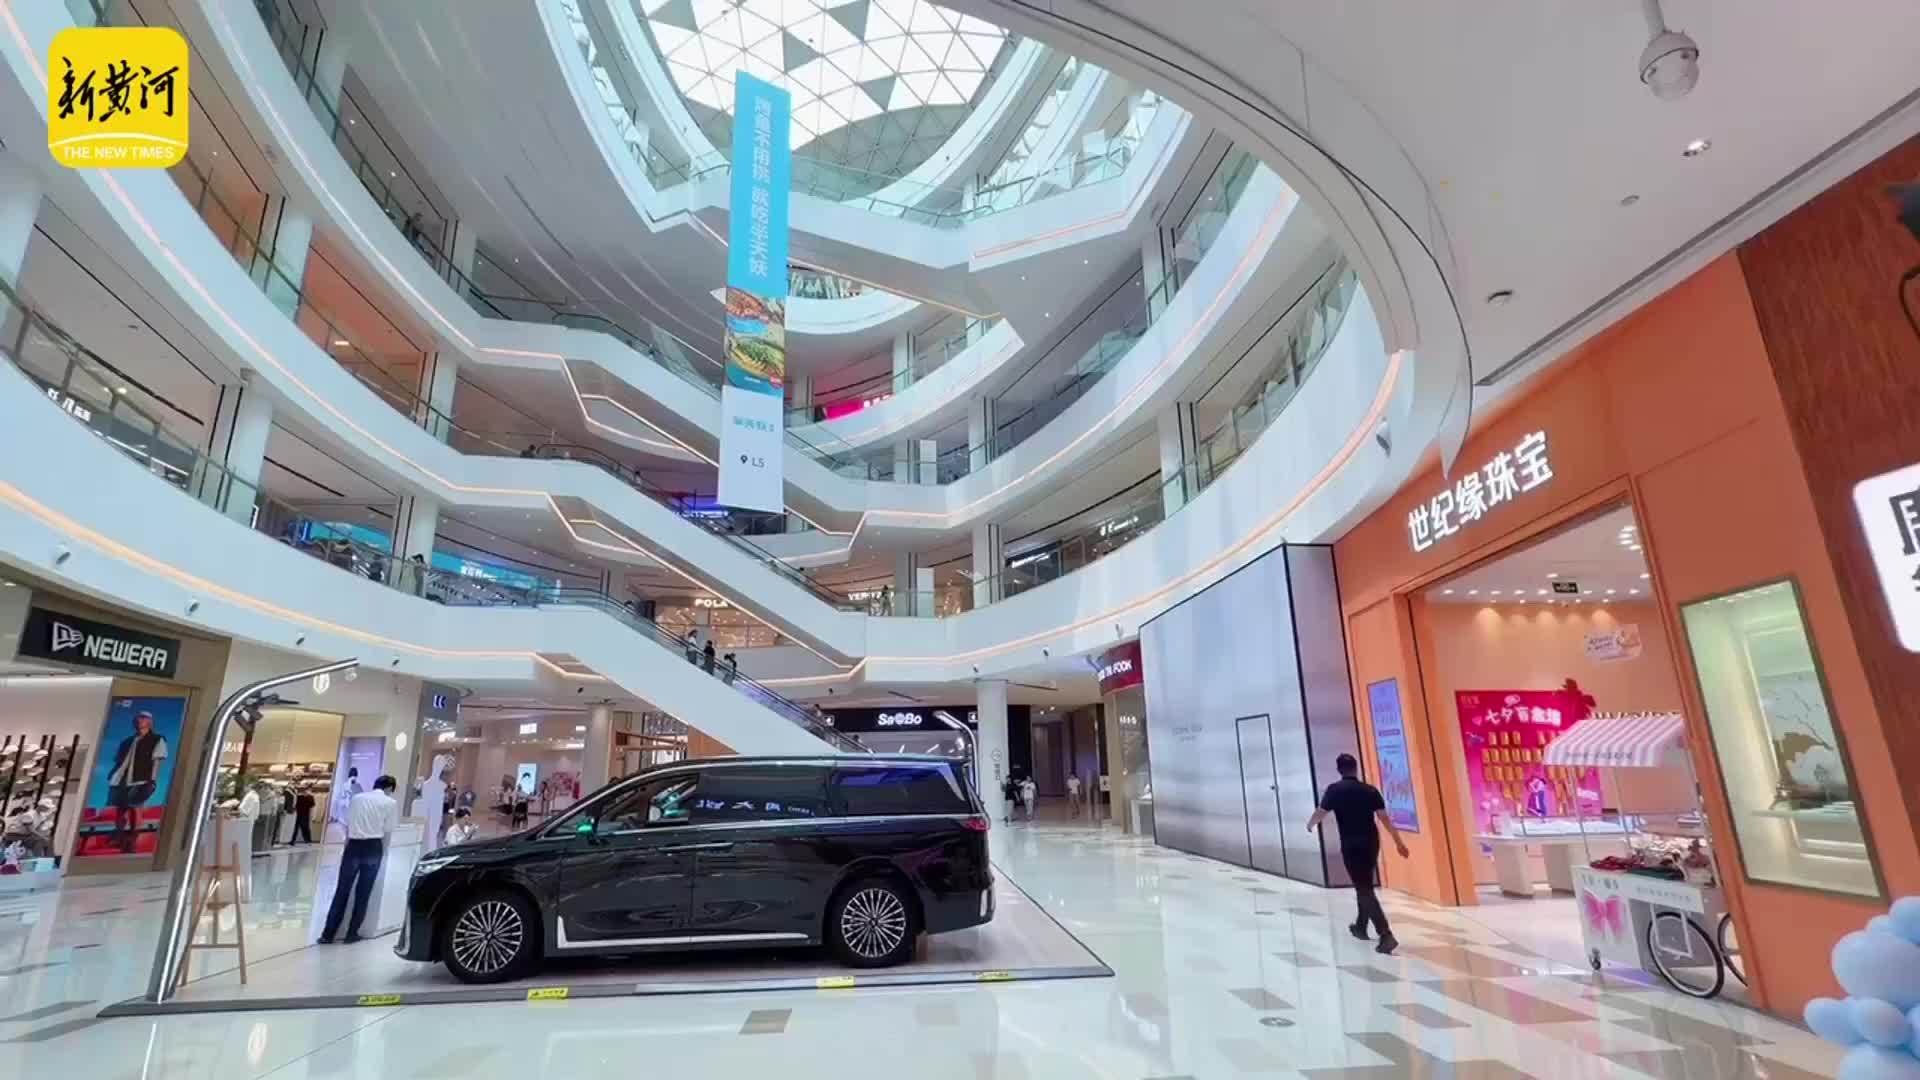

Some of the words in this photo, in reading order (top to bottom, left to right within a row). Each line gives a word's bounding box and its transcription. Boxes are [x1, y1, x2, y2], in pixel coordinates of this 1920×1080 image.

[752, 457, 765, 468] L5
[1408, 430, 1553, 552] 世纪缘珠宝
[694, 598, 728, 608] POLA
